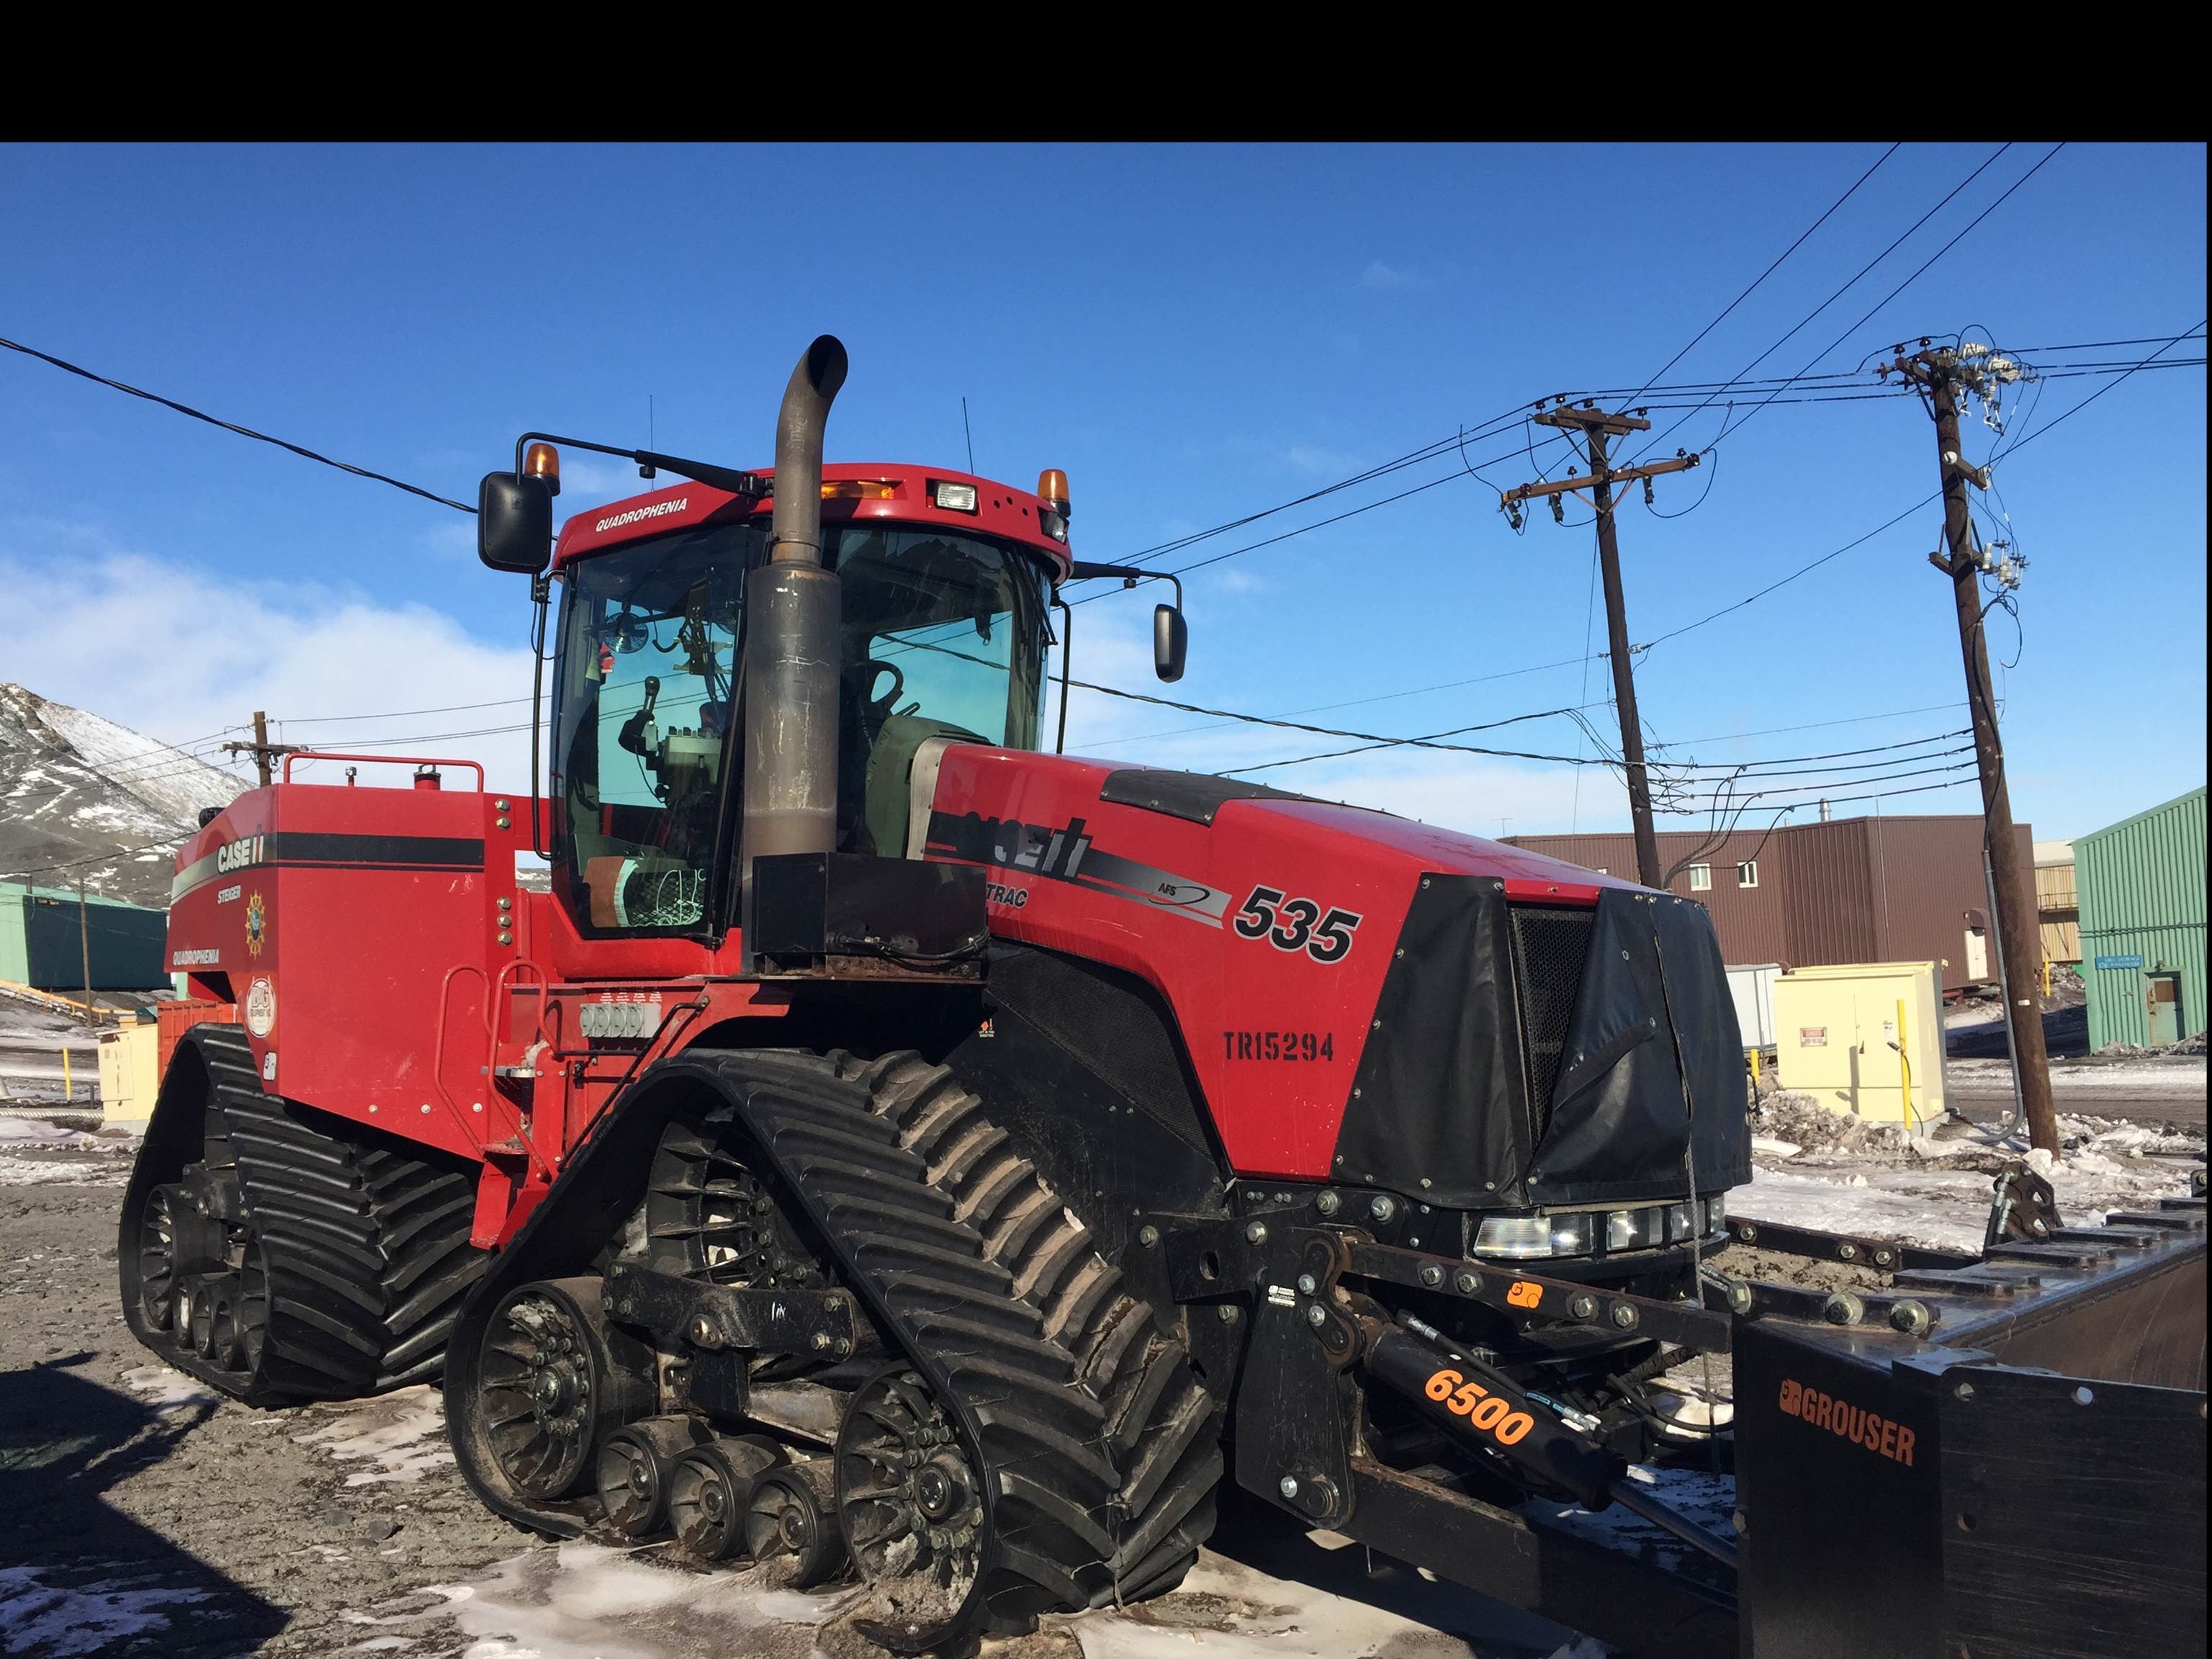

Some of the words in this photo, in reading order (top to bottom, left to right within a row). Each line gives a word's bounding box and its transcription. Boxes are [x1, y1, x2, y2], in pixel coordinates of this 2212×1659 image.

[595, 497, 688, 533] QUADROPHENIA
[217, 838, 251, 873] CASE
[217, 884, 242, 905] STEIGER
[1158, 882, 1177, 896] AFS
[1233, 884, 1364, 965] 535
[173, 948, 220, 966] QUADROPHENIA
[1223, 1030, 1334, 1061] TR15294
[1424, 1369, 1534, 1446] 6500
[1802, 1387, 1916, 1467] GROUSER
